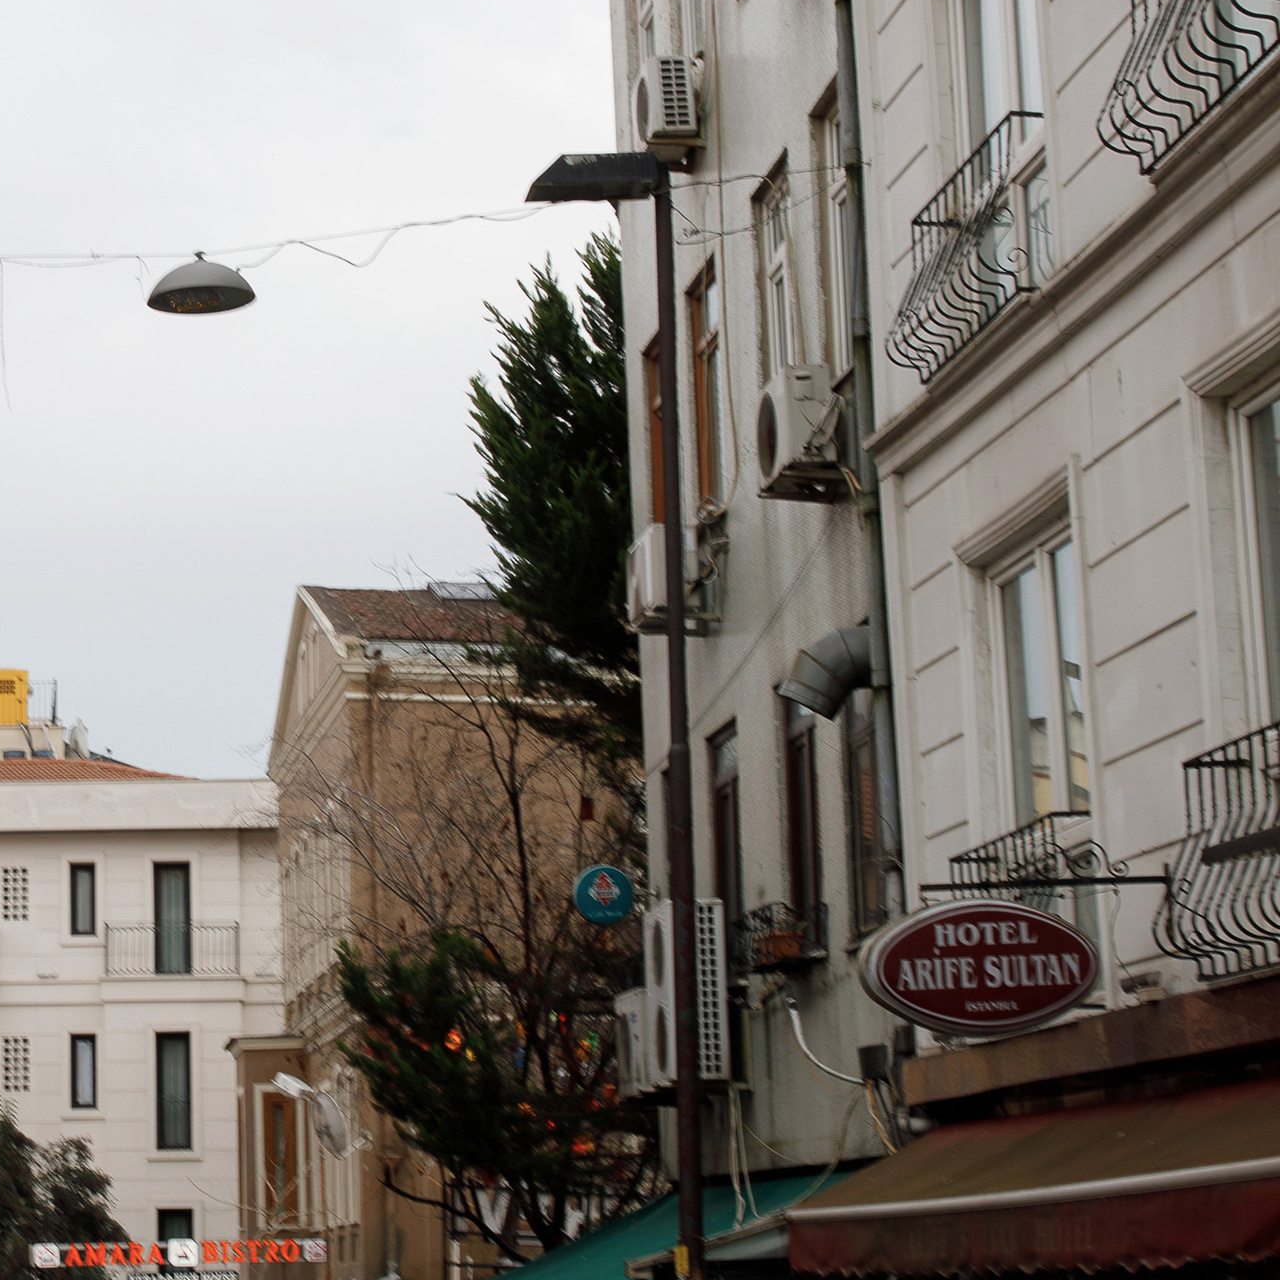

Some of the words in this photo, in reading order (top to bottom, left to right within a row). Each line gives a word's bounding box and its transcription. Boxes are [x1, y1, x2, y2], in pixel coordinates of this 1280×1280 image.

[933, 921, 1039, 947] HOTEL
[983, 954, 1082, 988] SULTAN
[1033, 1216, 1095, 1253] HOTEL
[65, 1241, 166, 1267] AMARA
[201, 1238, 301, 1265] BISTRO
